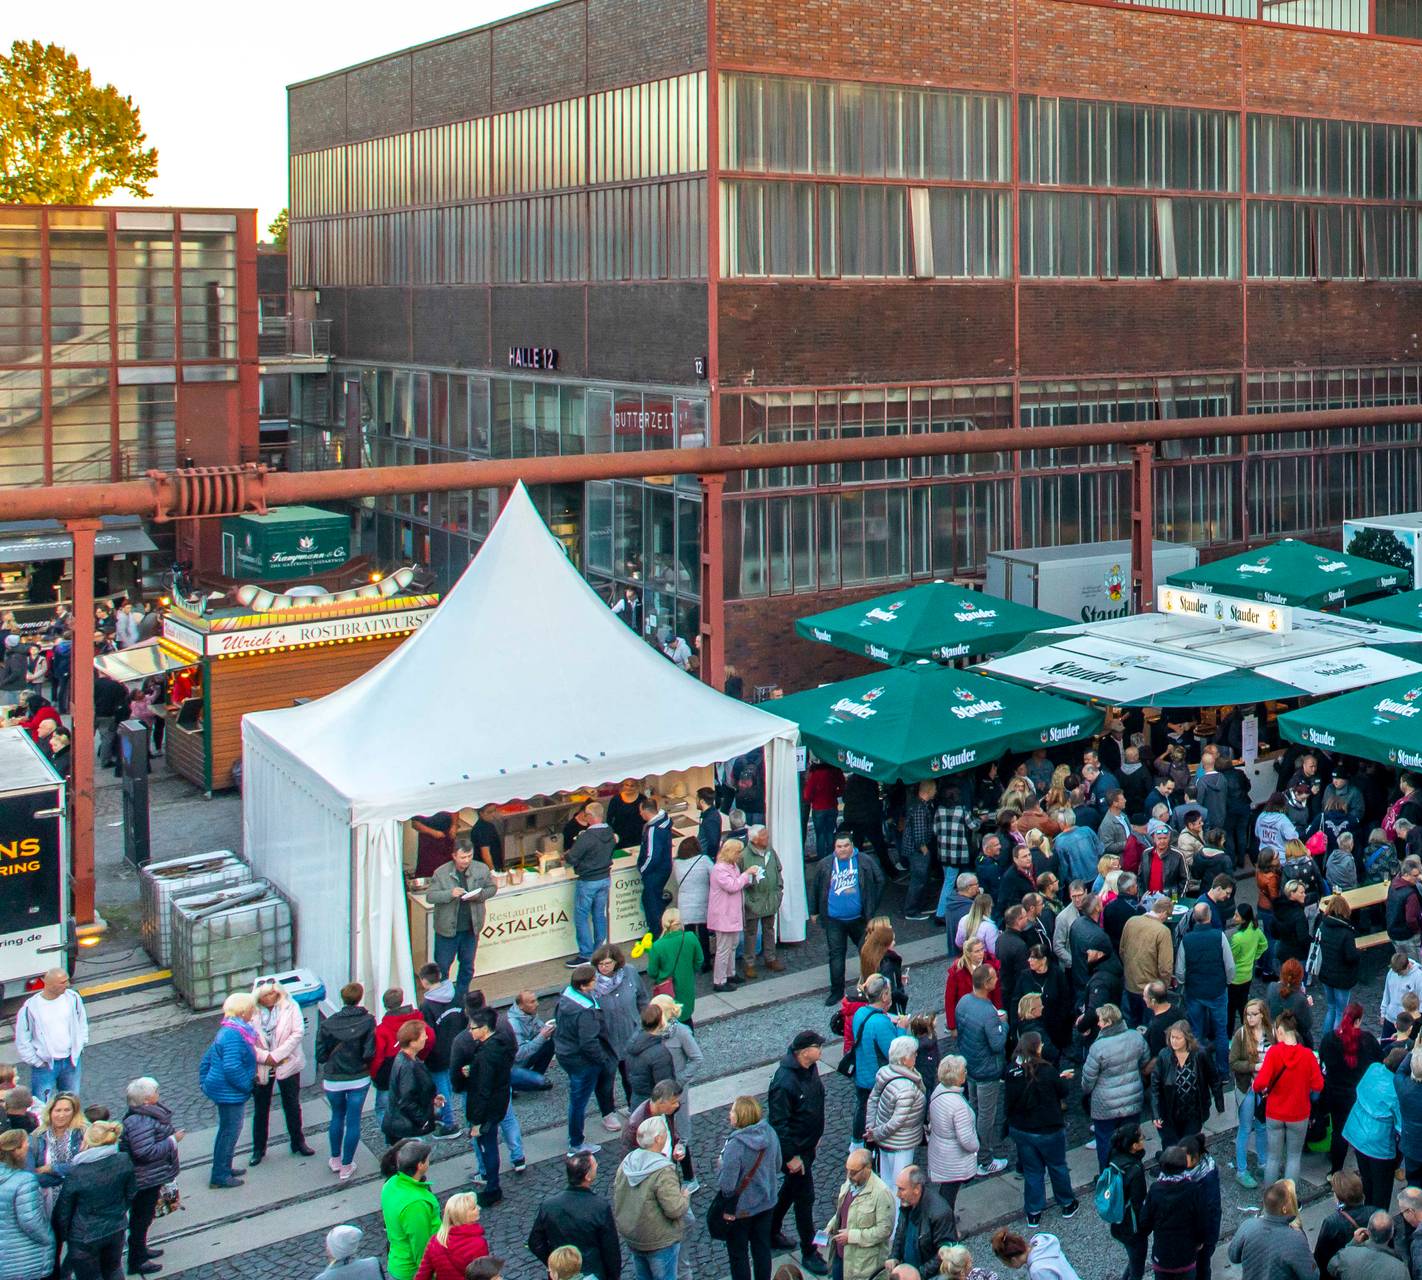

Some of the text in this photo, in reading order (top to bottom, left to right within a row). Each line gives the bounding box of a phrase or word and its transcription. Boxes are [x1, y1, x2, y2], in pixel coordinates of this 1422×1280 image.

[509, 347, 554, 369] HALLE 12
[694, 361, 703, 374] 12
[1381, 575, 1397, 587] Stauder
[1264, 591, 1287, 604] Stauder
[1328, 588, 1345, 602] Stauder
[954, 609, 999, 622] Stauder
[1081, 600, 1128, 623] Staud
[1180, 595, 1260, 624] Stauder Stauder
[814, 628, 832, 642] Stauder
[870, 644, 889, 660] Stauder
[941, 643, 971, 659] Stauder
[1040, 661, 1128, 684] Stauder
[1314, 664, 1367, 676] Stauder
[830, 698, 877, 719] Stauder
[951, 700, 1003, 719] Stauder
[1373, 698, 1421, 717] Stauder
[1050, 723, 1080, 742] Stauder
[1309, 727, 1336, 747] Stauder
[845, 751, 874, 772] Stauder
[941, 750, 976, 770] Stauder
[0, 838, 40, 858] NS
[0, 861, 40, 876] RING
[615, 878, 641, 890] Gyro
[489, 904, 547, 921] Restaurant
[482, 909, 569, 939] OSTALGIA
[0, 934, 42, 947] ring.de
